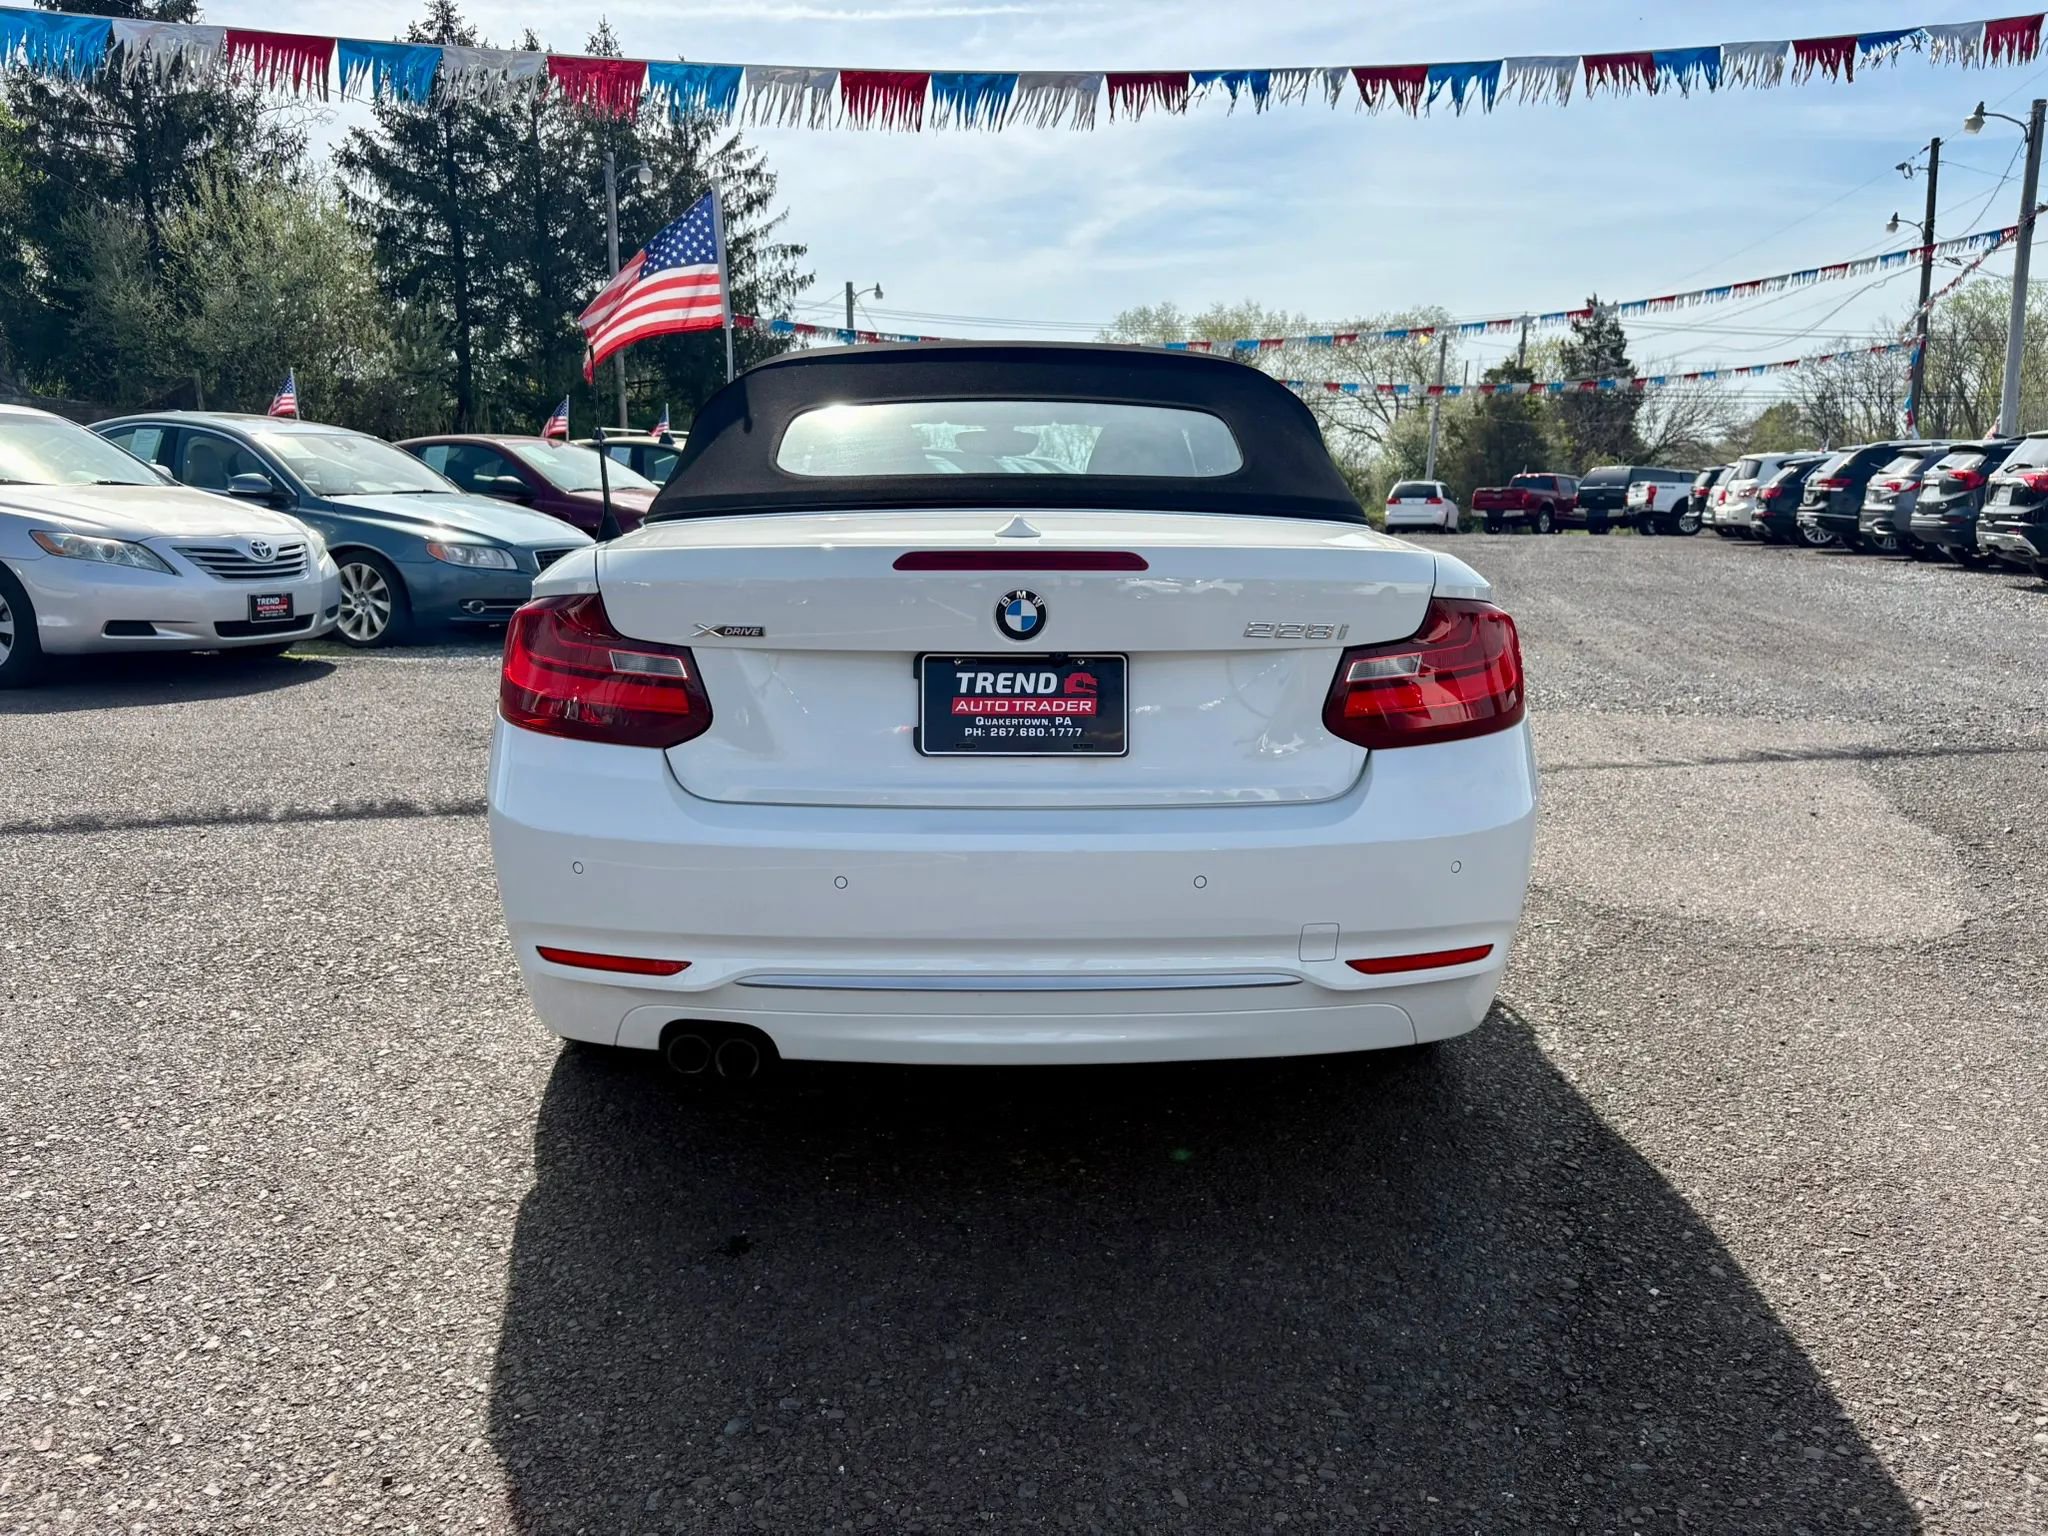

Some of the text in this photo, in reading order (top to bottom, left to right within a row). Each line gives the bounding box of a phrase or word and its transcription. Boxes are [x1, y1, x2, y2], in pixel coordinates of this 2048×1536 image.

[256, 597, 280, 605] TREND
[1000, 590, 1044, 608] BMW
[1243, 621, 1350, 641] 228i
[955, 672, 1058, 694] TREND
[955, 700, 1092, 712] AUTO TRADER
[975, 716, 1072, 727] QUAKERTOWN, PA
[964, 728, 1083, 737] PH: 267.680.1777
